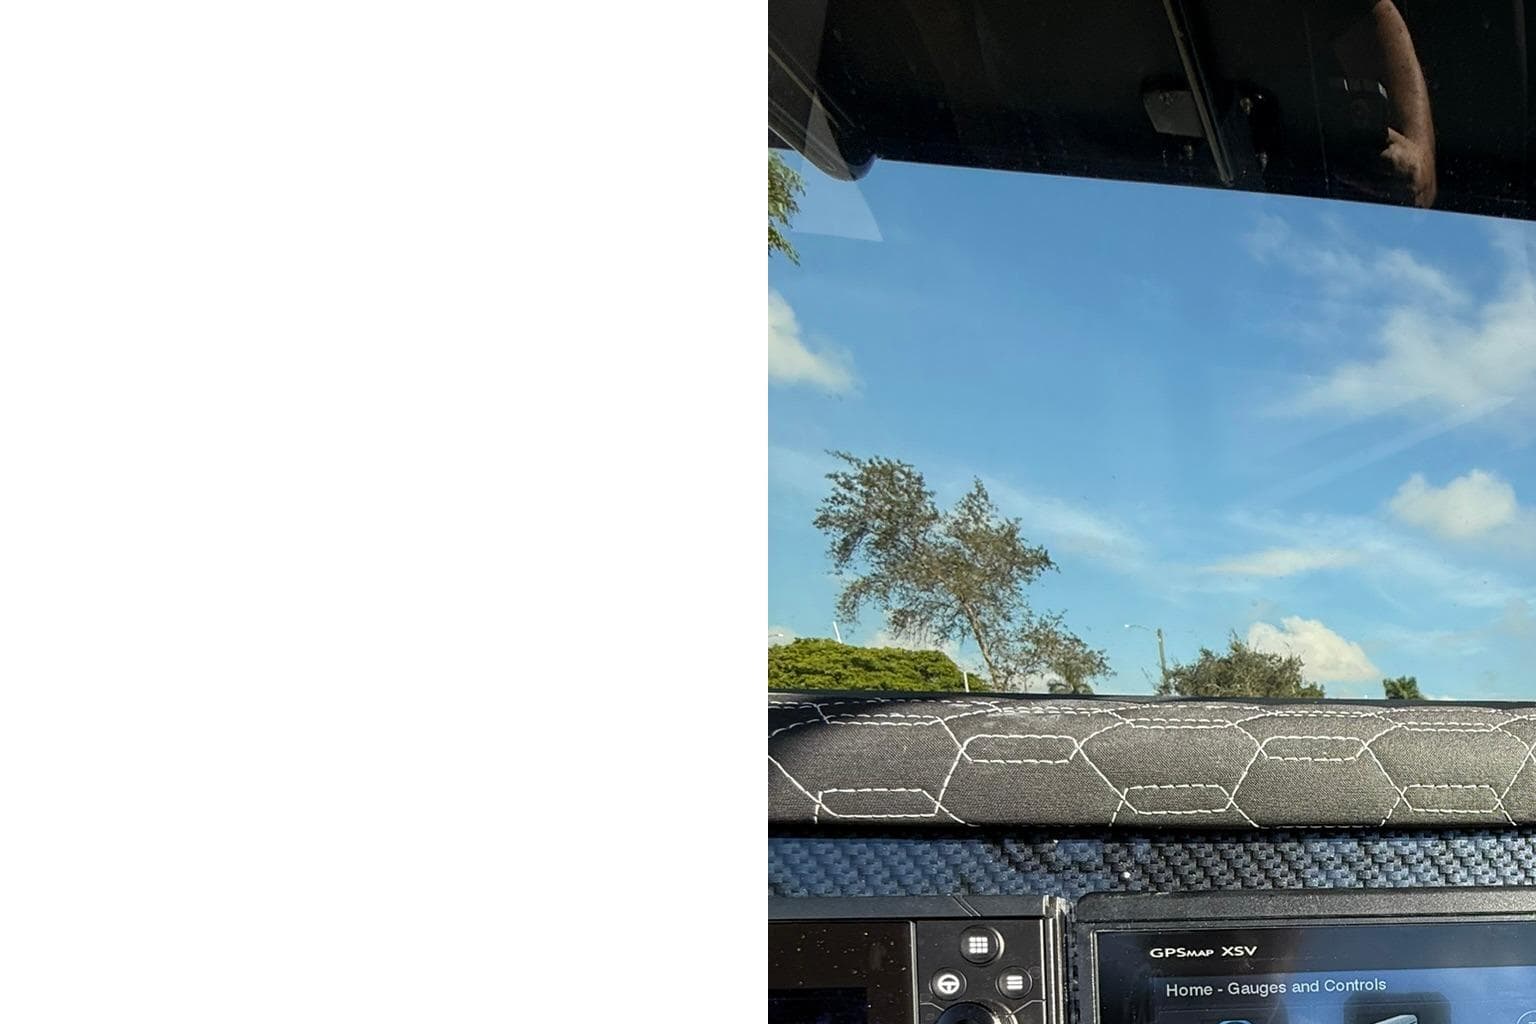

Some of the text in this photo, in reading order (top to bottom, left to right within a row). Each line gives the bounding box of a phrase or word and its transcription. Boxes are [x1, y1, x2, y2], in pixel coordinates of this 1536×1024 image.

[1222, 946, 1257, 957] XSV
[1166, 984, 1213, 997] Home
[1228, 982, 1286, 997] Gauges
[1292, 980, 1319, 993] and
[1325, 979, 1387, 992] Controls
